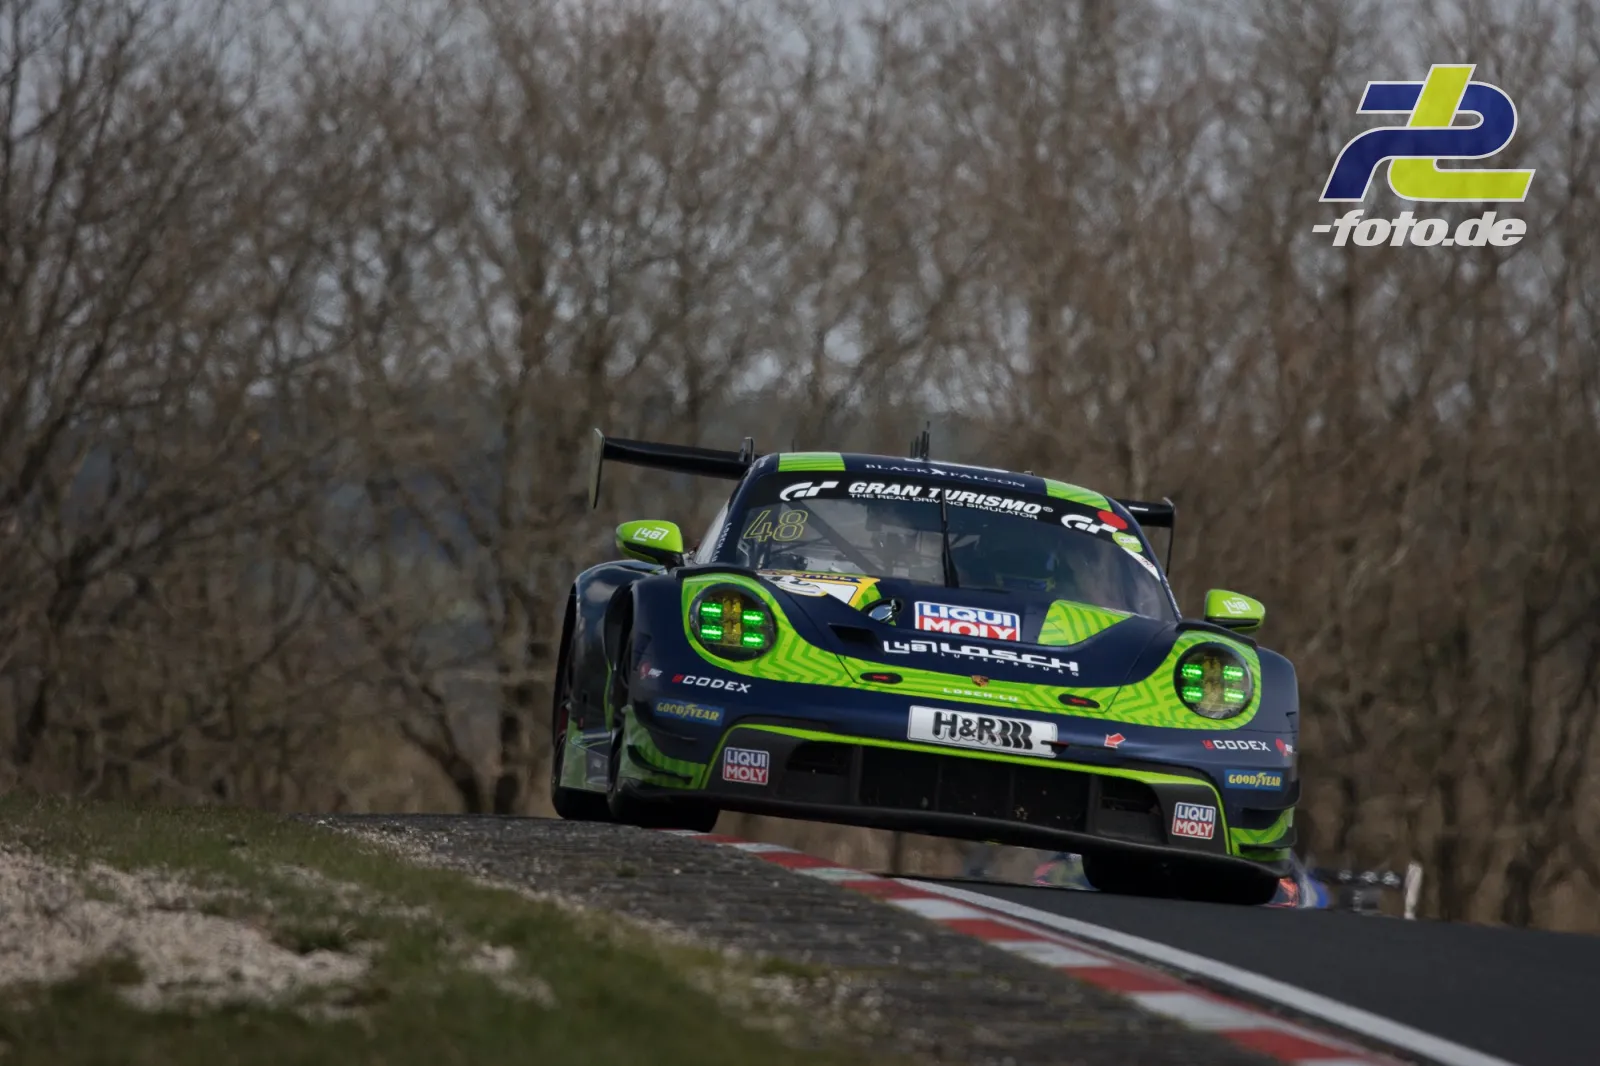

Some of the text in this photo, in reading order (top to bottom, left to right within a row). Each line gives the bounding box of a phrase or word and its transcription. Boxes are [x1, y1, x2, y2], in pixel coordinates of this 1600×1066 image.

[865, 463, 1025, 488] BLACK FALCON
[848, 481, 922, 497] GRAN
[912, 496, 964, 507] DRIVNG
[966, 502, 1038, 520] SIMULATOR
[743, 509, 808, 542] 48
[923, 604, 1012, 626] LIQUI
[940, 642, 1079, 672] LOSCH
[682, 675, 752, 693] CODEX
[943, 687, 1018, 702] LOSCH.LU
[656, 702, 720, 721] GOODYEAR
[932, 710, 1000, 746] H&R
[1212, 739, 1271, 752] CODEX
[727, 750, 766, 767] LIQUI
[726, 764, 766, 782] MOLY
[1228, 772, 1281, 788] GOODYEAR
[1177, 805, 1213, 822] LIQUI
[1175, 819, 1213, 837] MOLY
